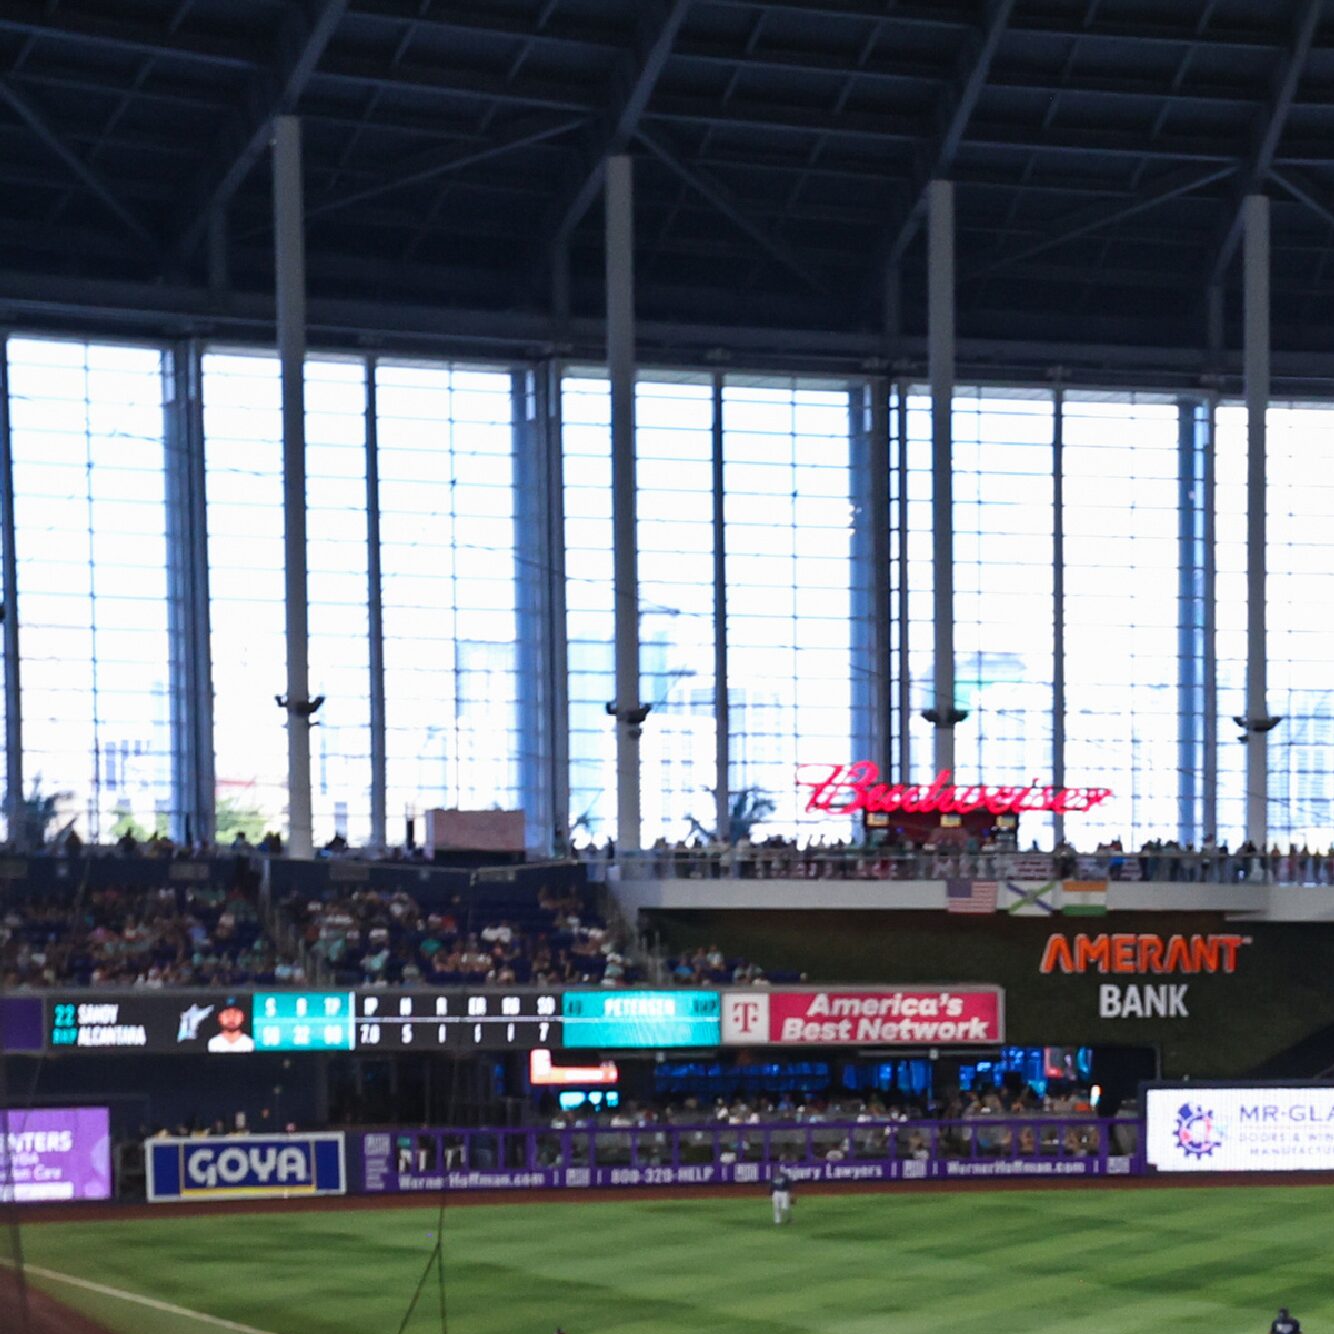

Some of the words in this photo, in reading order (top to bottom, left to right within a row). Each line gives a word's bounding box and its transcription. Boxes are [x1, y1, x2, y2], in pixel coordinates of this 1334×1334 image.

[797, 761, 1112, 814] Budweiser
[1040, 934, 1246, 973] AMERANT
[55, 1004, 76, 1026] 22
[806, 992, 963, 1017] America's
[1099, 984, 1190, 1018] BANK
[781, 1018, 851, 1040] Best
[857, 1017, 990, 1041] Network
[188, 1148, 307, 1188] GOYA
[825, 1161, 883, 1179] Lawyers
